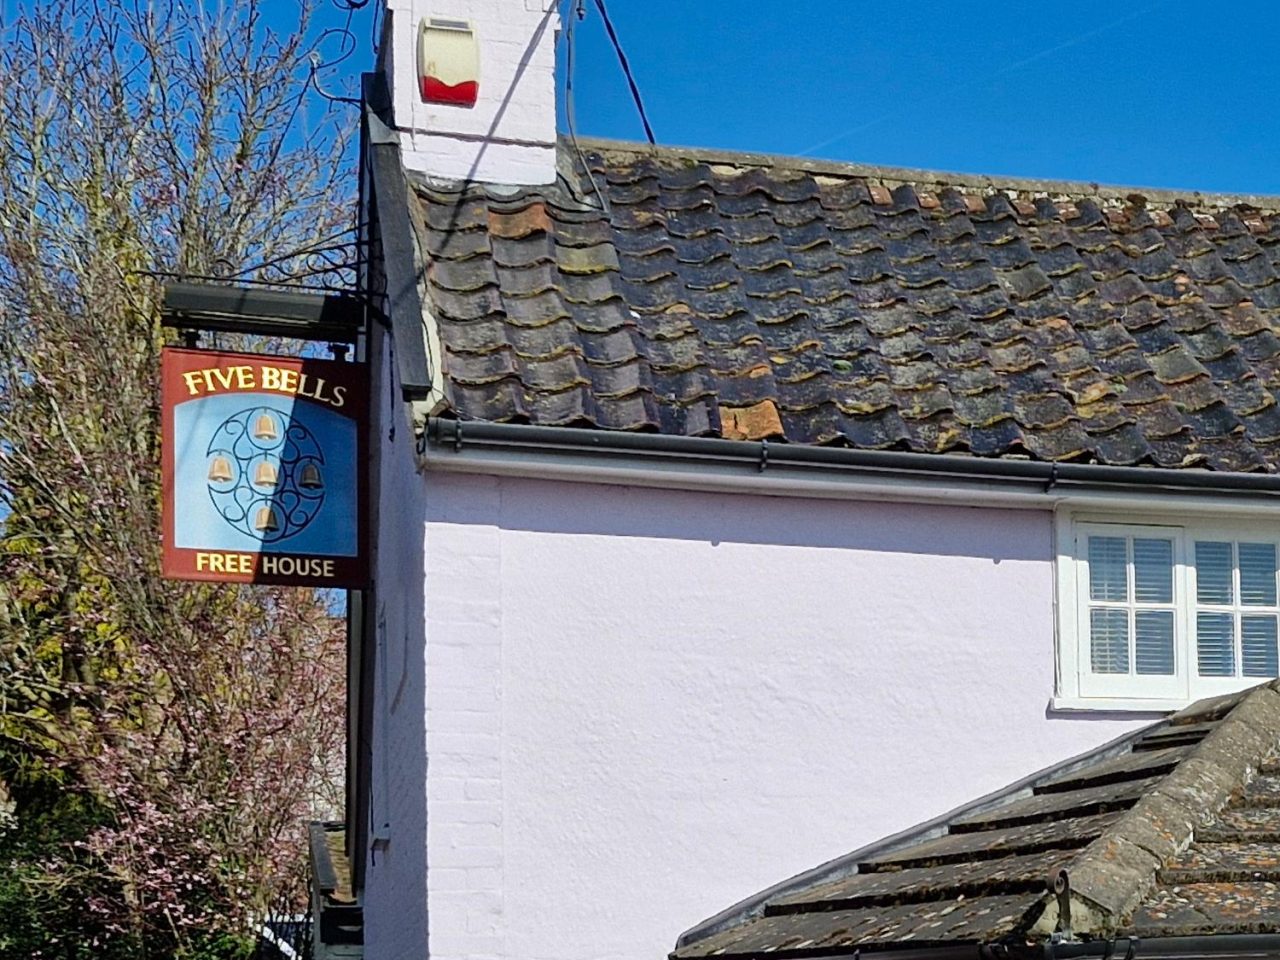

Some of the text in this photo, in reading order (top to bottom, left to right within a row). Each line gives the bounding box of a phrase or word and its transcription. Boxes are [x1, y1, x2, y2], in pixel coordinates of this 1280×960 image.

[183, 366, 347, 407] FIVE BELLS
[196, 552, 335, 577] FREE HOUSE
